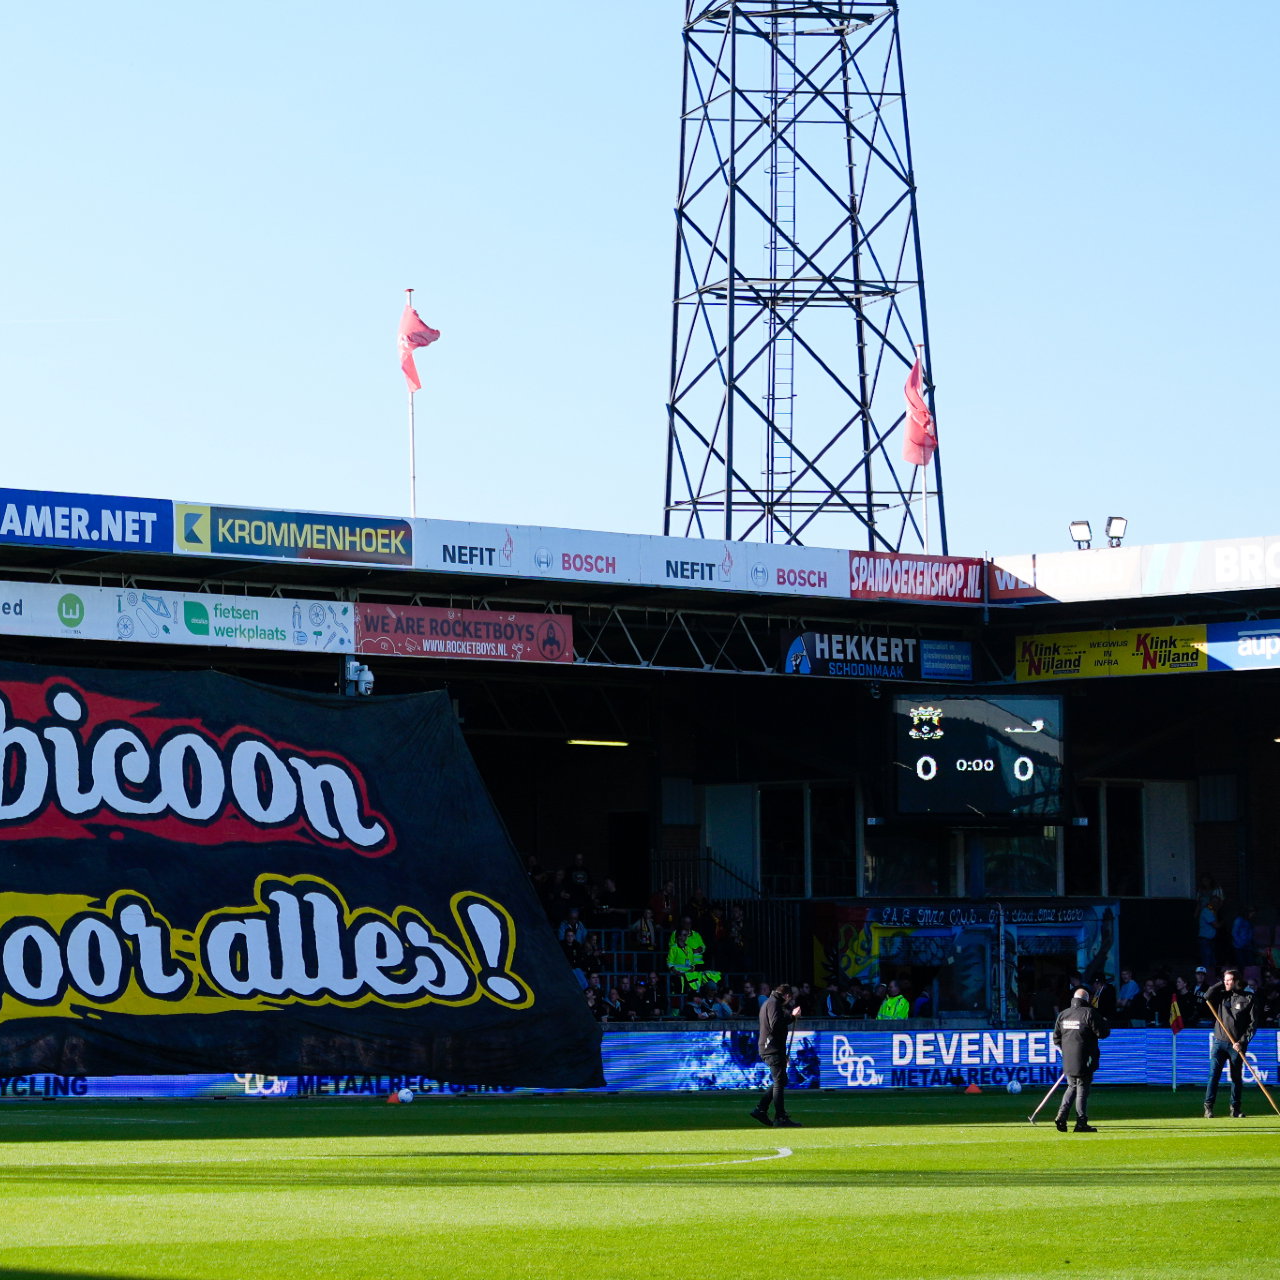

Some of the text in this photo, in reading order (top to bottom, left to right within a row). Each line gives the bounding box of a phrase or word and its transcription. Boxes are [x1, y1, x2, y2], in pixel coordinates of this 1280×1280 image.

[218, 518, 406, 554] KROMMENHOEK
[442, 545, 496, 566] NEFIT
[562, 553, 616, 574] BOSCH
[666, 560, 716, 581] NEFIT
[776, 568, 828, 588] BOSCH
[850, 556, 982, 598] SPANDOEKENSHOP.NL
[214, 602, 259, 621] fietsen
[214, 623, 286, 641] werkplaats
[364, 615, 535, 641] WE ARE ROCKETBOYS
[422, 639, 508, 656] WWW.ROCKETBOYS.NL
[815, 633, 917, 663] HEKKERT
[1090, 640, 1128, 649] WEGWIJS
[1136, 633, 1178, 652] Klink
[1094, 659, 1119, 667] INFRA
[1104, 650, 1112, 658] IN
[1142, 649, 1199, 670] Nijland
[829, 662, 904, 678] SCHOONMAAK
[916, 756, 1034, 781] 0 0:00 0
[203, 890, 521, 1002] alles!
[892, 1067, 1063, 1087] METAALRECYCLIN
